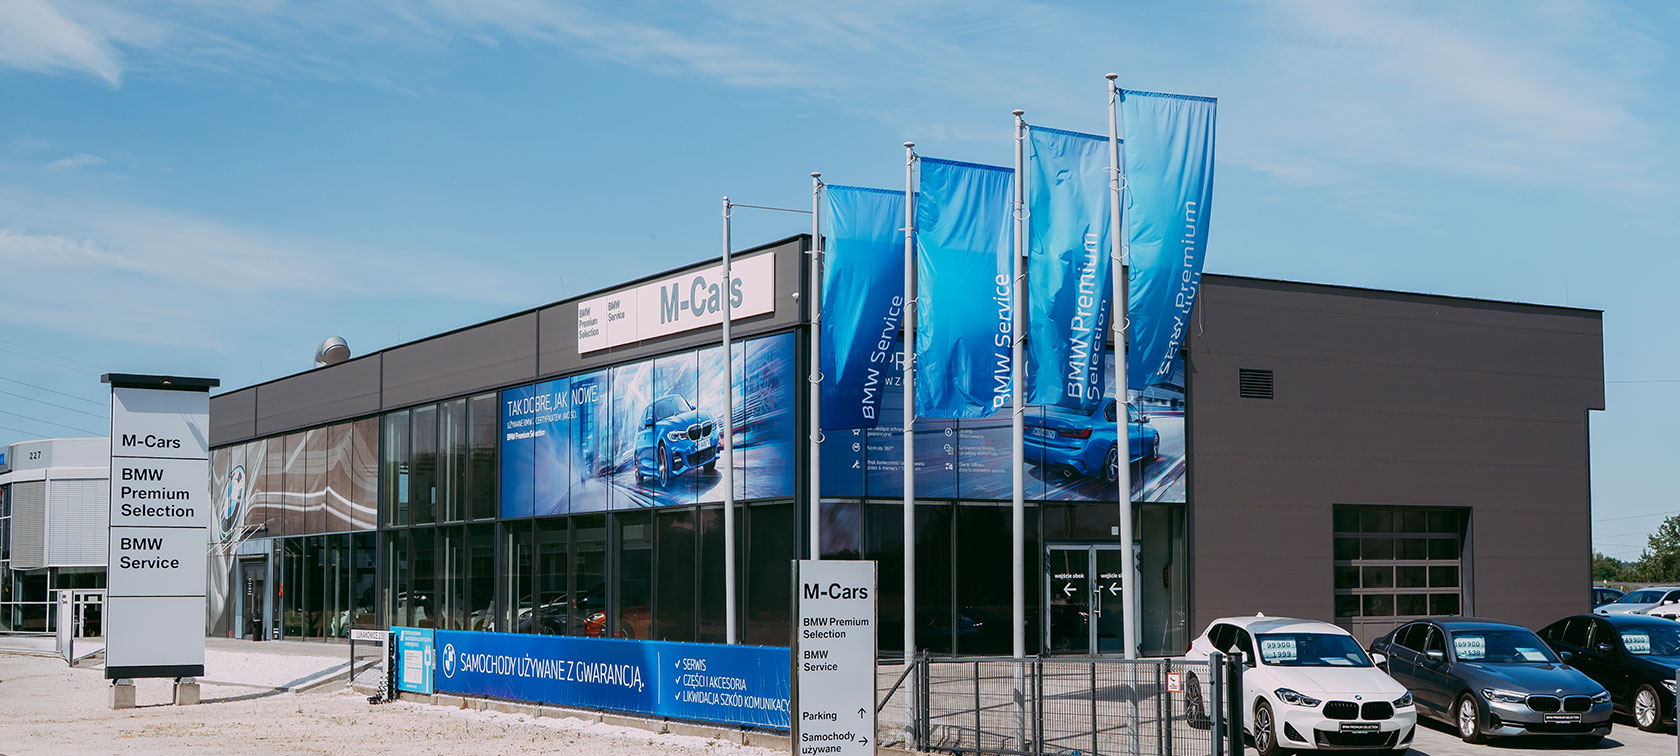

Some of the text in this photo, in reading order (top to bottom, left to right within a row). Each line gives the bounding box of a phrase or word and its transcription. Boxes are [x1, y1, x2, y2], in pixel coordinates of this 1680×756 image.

[1175, 200, 1197, 308] Premium
[608, 300, 621, 312] BMW
[660, 275, 743, 325] M-Cas
[579, 307, 591, 319] BMW
[608, 310, 625, 323] Service
[1067, 232, 1098, 399] BMW Premium
[579, 317, 598, 329] Premium
[870, 295, 903, 364] Service
[579, 327, 600, 340] Selection
[993, 273, 1012, 409] BMW Service
[1086, 299, 1106, 400] Selection
[861, 368, 880, 420] BMW
[507, 400, 522, 417] TAK
[553, 391, 568, 411] JAK
[122, 434, 181, 449] M-Cars
[516, 431, 530, 440] Premium
[29, 451, 41, 460] 227
[121, 467, 164, 482] BMW
[121, 486, 190, 500] Premium
[121, 503, 195, 518] Selection
[120, 537, 163, 551] BMW
[120, 555, 180, 569] Service
[803, 583, 869, 600] M-Cars
[803, 617, 869, 627] BMW Premium
[803, 629, 846, 639] Selection
[1267, 641, 1291, 649] 99900
[803, 650, 829, 660] BMW
[1272, 650, 1292, 658] 1999
[683, 657, 707, 672] SERWIS
[803, 662, 838, 672] Service
[460, 652, 645, 693] SAMOCHODY UŻYWANE Z GWARANCJĄ.
[683, 673, 705, 689] CZĘŚCI
[709, 676, 747, 691] AKCESORIA
[683, 690, 791, 713] LIKWIDACJA SZKÓD KOMUNIKACY
[802, 711, 837, 722] Parking
[802, 731, 856, 742] Samochody
[802, 745, 842, 756] używane
